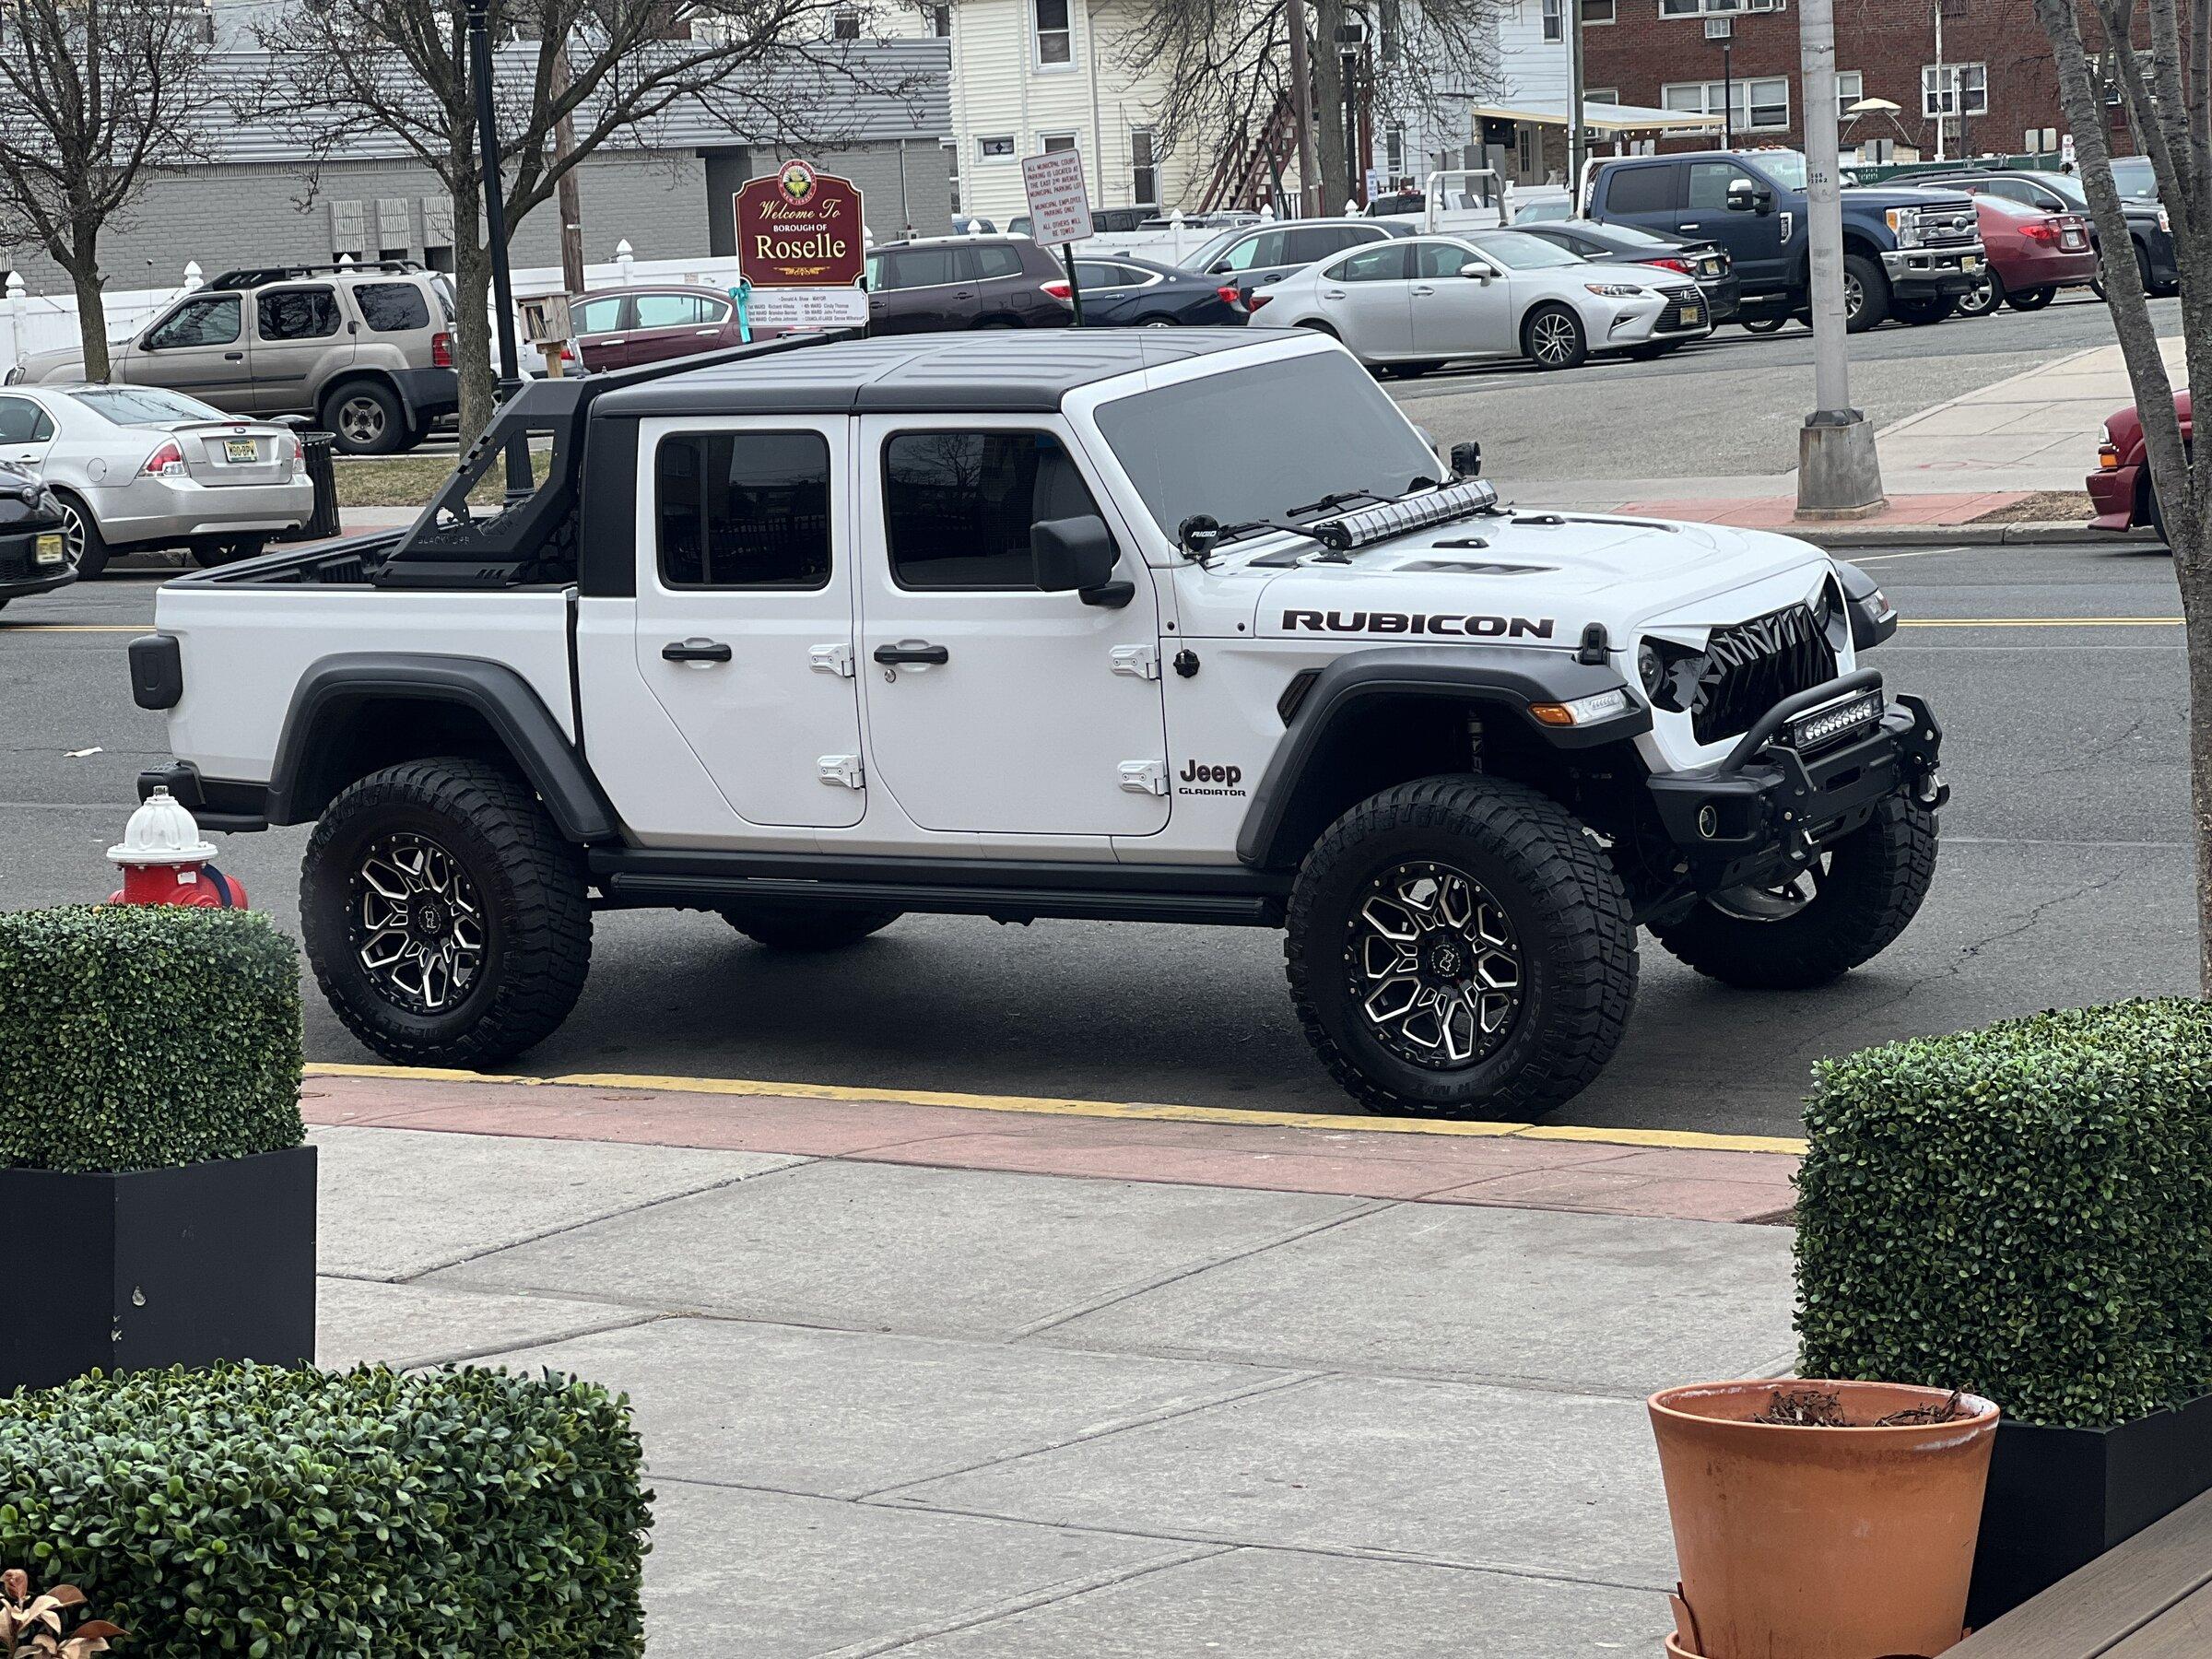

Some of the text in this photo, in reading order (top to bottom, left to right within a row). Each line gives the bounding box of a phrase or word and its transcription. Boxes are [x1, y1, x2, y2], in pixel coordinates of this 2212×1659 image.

[1037, 160, 1060, 171] MUNICIPAL
[1027, 172, 1046, 181] PARKING
[1053, 167, 1073, 176] LOCATED
[1062, 174, 1078, 183] AVENUE
[1030, 182, 1082, 198] MUNICIPAL PARKING LOT
[759, 198, 842, 220] Welcome To
[1035, 196, 1082, 210] MUNICIPAL EMPLOYEE
[1043, 206, 1076, 217] PARKING ONLY
[773, 224, 817, 232] BOROUGH
[1053, 220, 1070, 229] OTHERS
[1060, 227, 1075, 236] TOWED
[755, 233, 846, 259] Roselle
[1282, 609, 1555, 640] RUBICON
[1180, 759, 1241, 787] Jeep
[1178, 787, 1247, 797] GLADIATOR
